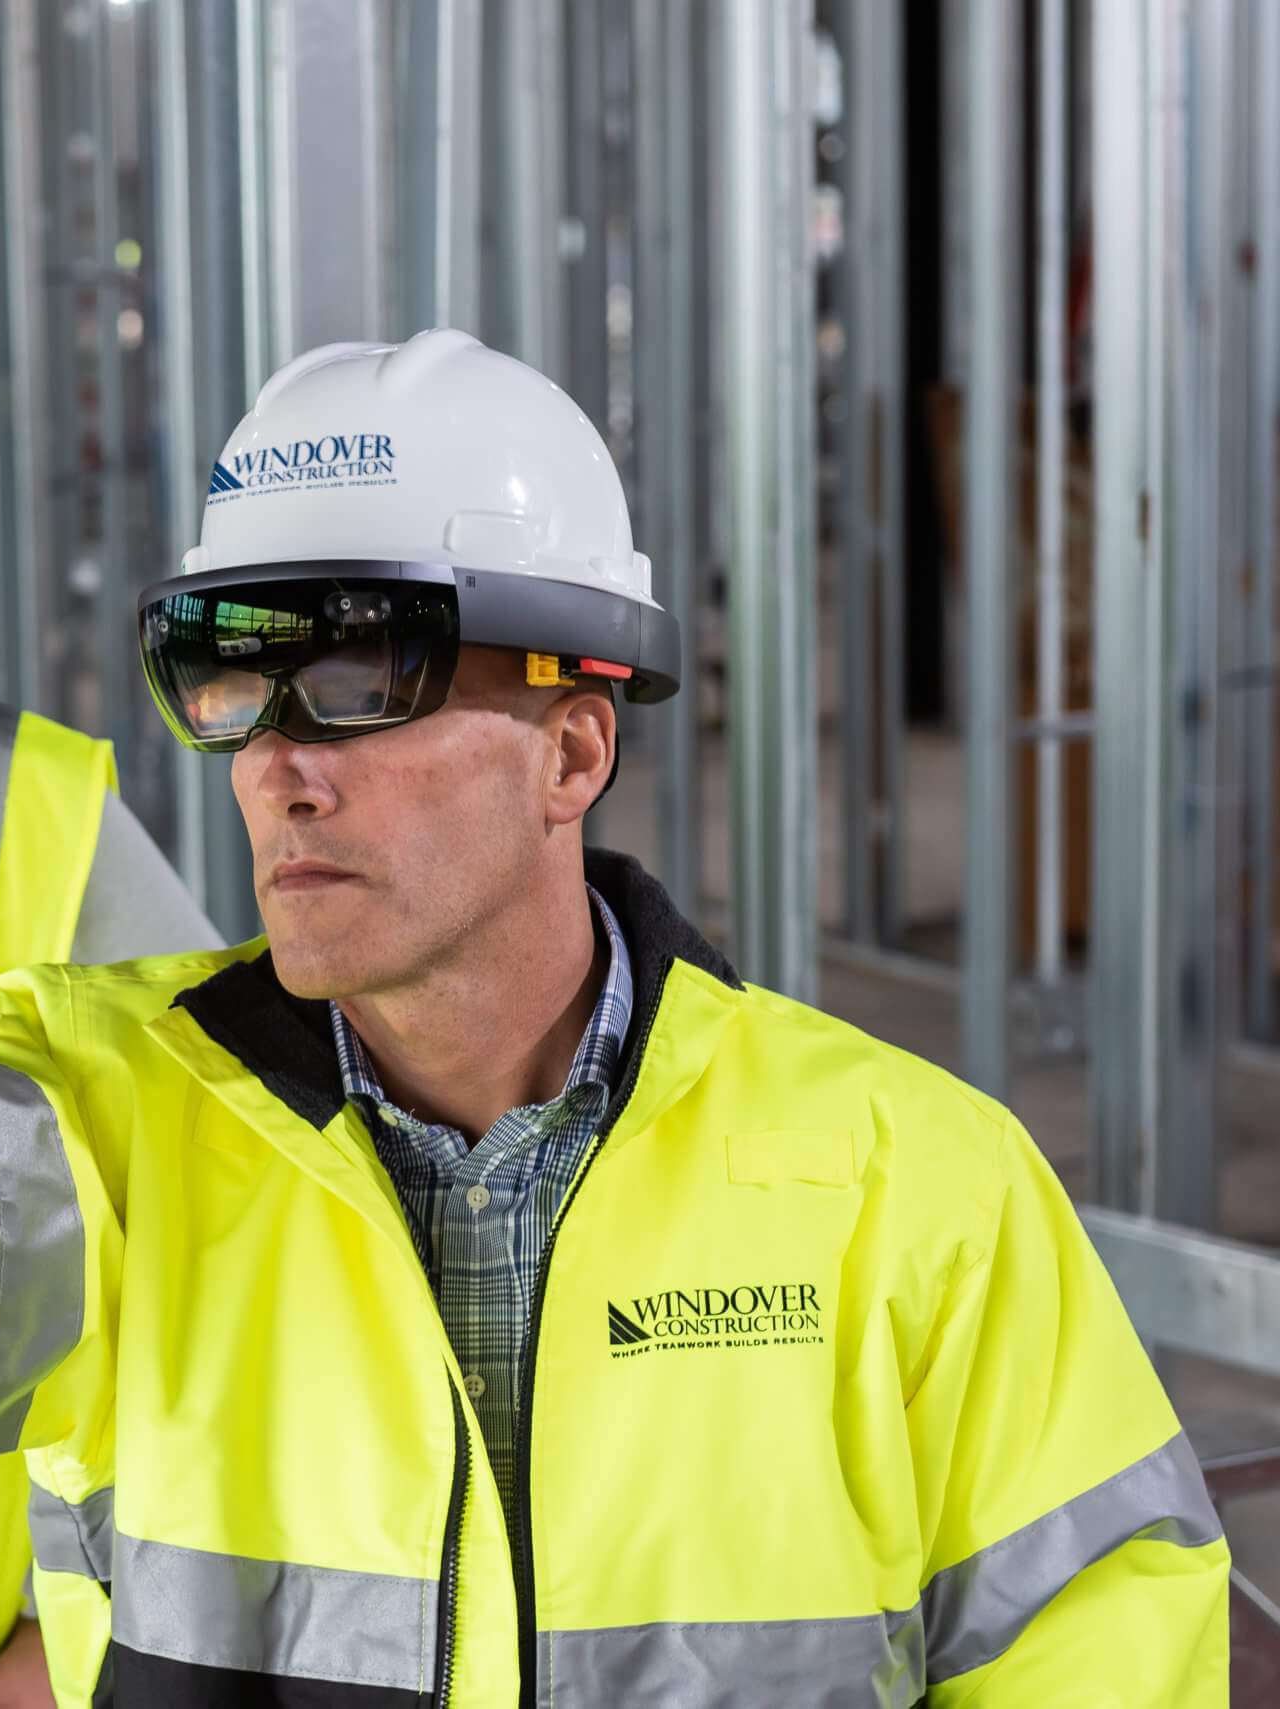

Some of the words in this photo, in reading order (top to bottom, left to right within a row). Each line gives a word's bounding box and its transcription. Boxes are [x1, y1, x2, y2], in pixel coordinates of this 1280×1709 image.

[233, 433, 396, 475] WINDOVER
[247, 460, 393, 488] CONSTRUCTION
[631, 1283, 821, 1325] WINDOVER
[653, 1313, 820, 1337] CONSTRUCTION
[611, 1345, 650, 1359] WHERE
[655, 1340, 721, 1351] TEAMWORK
[725, 1337, 768, 1347] BUILDS
[773, 1336, 824, 1344] RESULTS
